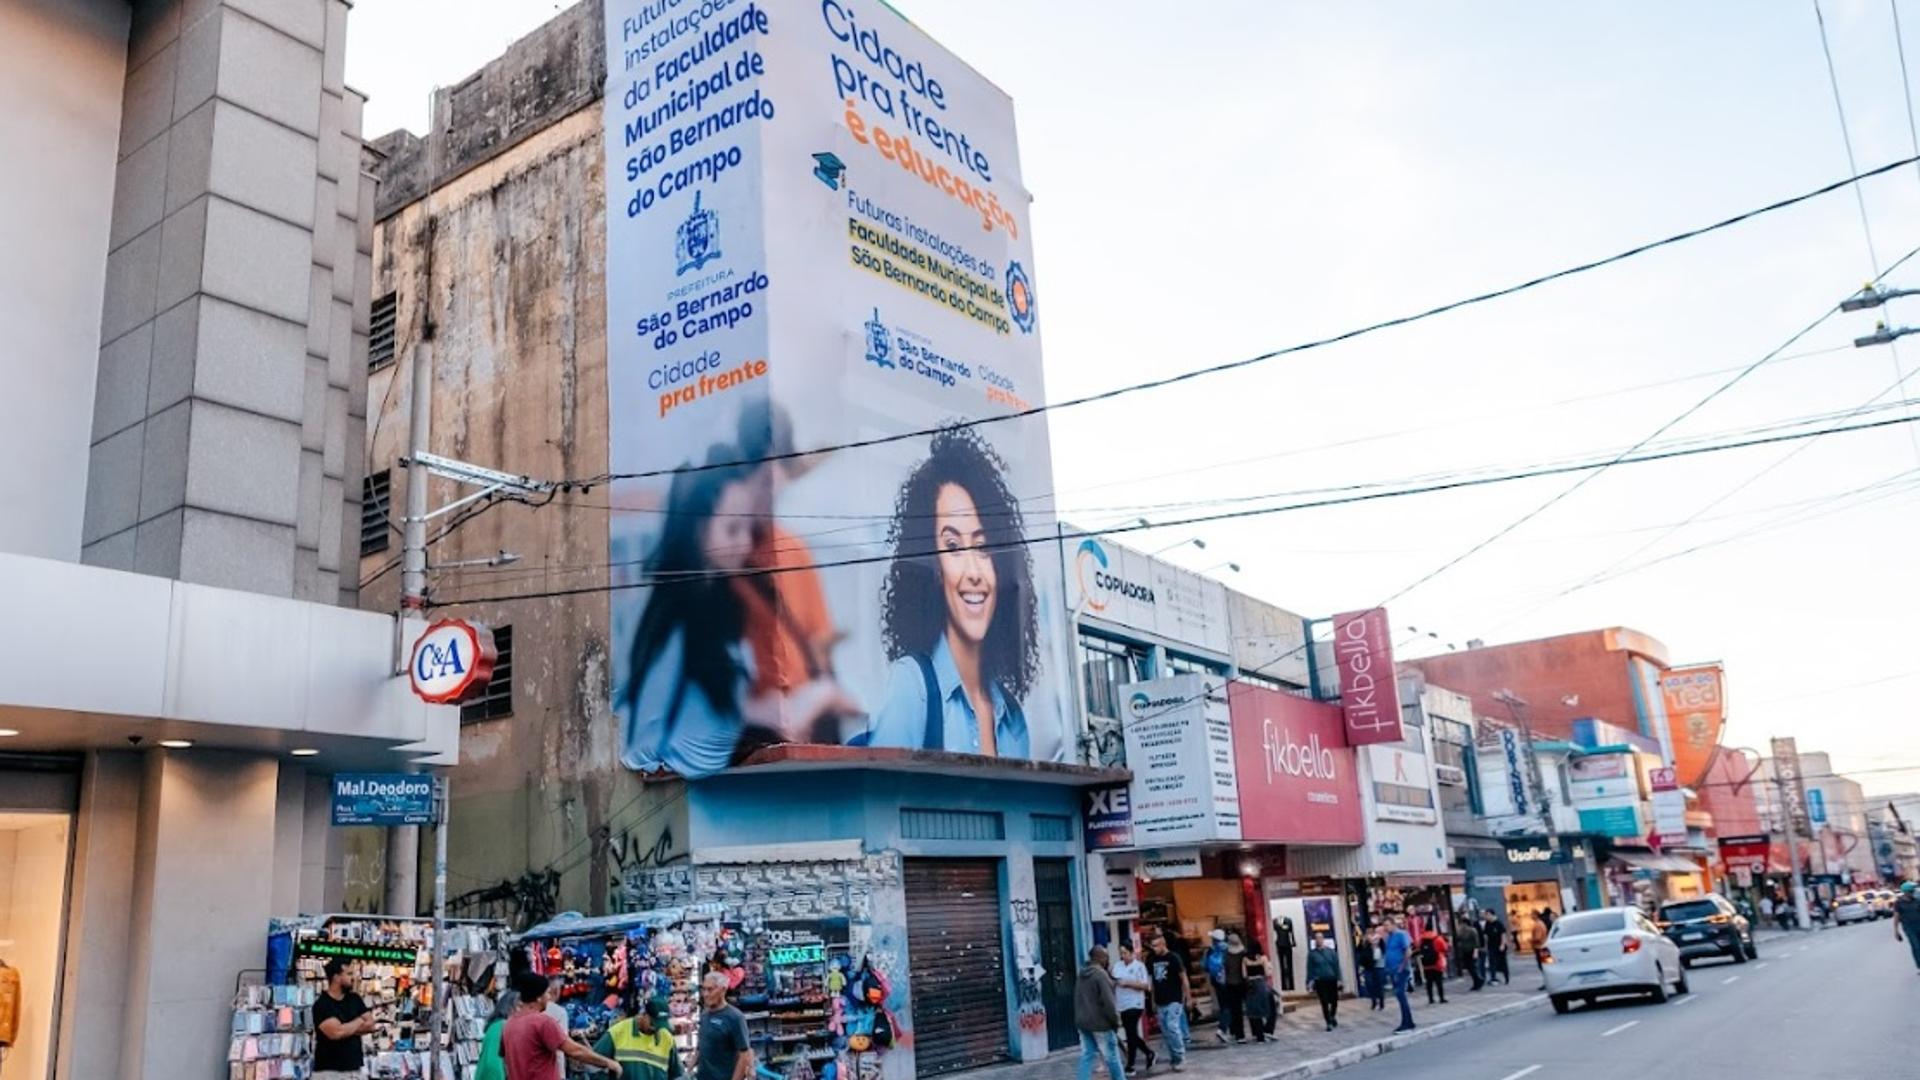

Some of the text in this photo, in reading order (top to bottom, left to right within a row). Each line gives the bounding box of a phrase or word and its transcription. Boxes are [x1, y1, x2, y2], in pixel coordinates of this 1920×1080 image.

[623, 0, 681, 42] Futura
[625, 0, 735, 71] instalaçõe
[823, 0, 946, 110] Cidade
[624, 4, 768, 109] da Faculdade
[625, 51, 764, 147] Municipal de
[831, 54, 992, 182] pra frente
[626, 90, 774, 182] São Bernardo
[845, 99, 1018, 240] é educação
[628, 146, 742, 218] do Campo
[849, 190, 995, 280] Futuras instalações da
[849, 217, 1005, 309] Faculdade Municipal de
[637, 271, 769, 336] São Bernardo
[667, 268, 735, 300] PREFEITURA
[852, 245, 1010, 334] São Bernardo do Campo
[654, 302, 752, 350] do Campo
[898, 337, 972, 378] São Bernardo
[649, 350, 721, 390] Cidade
[660, 359, 767, 418] pra frente
[900, 355, 956, 387] do Campo
[1096, 571, 1155, 605] COPIADORA
[418, 638, 464, 681] C&A
[1340, 619, 1395, 732] fikbella
[1263, 718, 1335, 784] fikbella
[1089, 788, 1129, 815] XE
